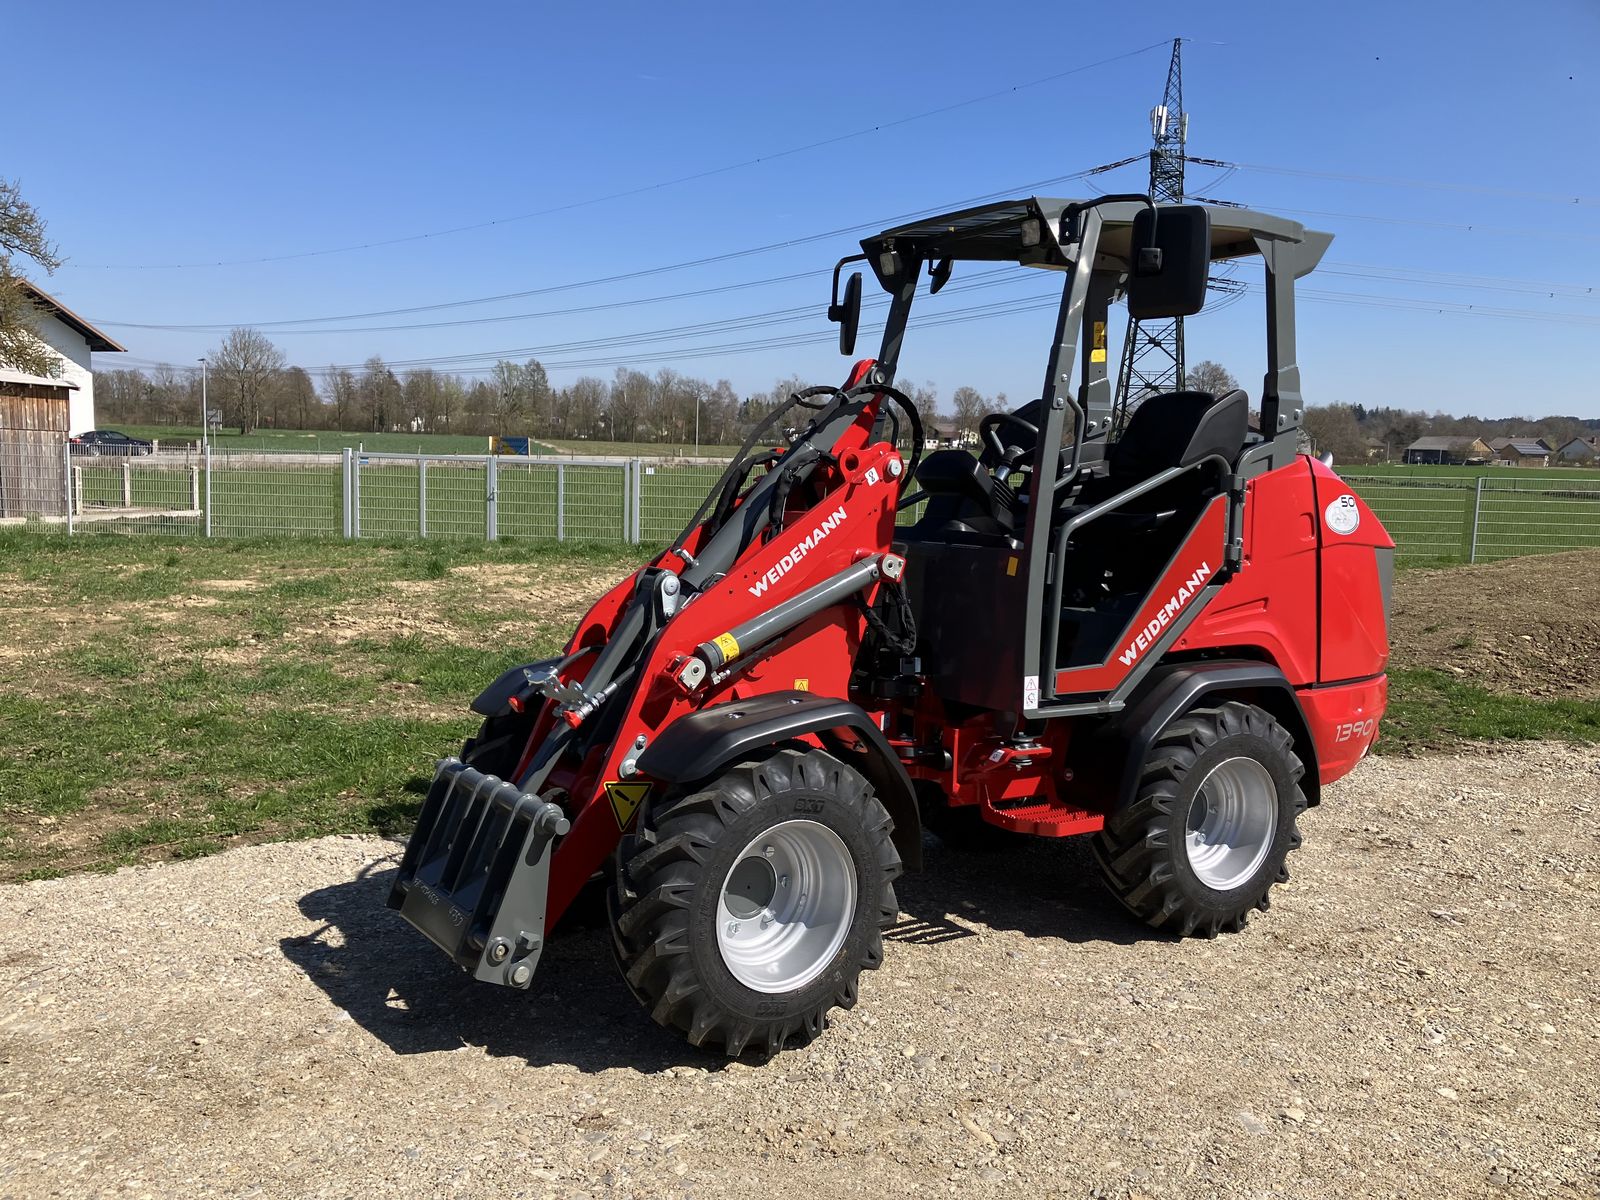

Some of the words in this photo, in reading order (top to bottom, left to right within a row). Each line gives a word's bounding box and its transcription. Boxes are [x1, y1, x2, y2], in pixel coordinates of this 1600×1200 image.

[1341, 496, 1355, 508] 50
[748, 505, 848, 598] WEIDEMANN
[1118, 561, 1211, 667] WEIDEMANN
[1335, 718, 1374, 743] 1390
